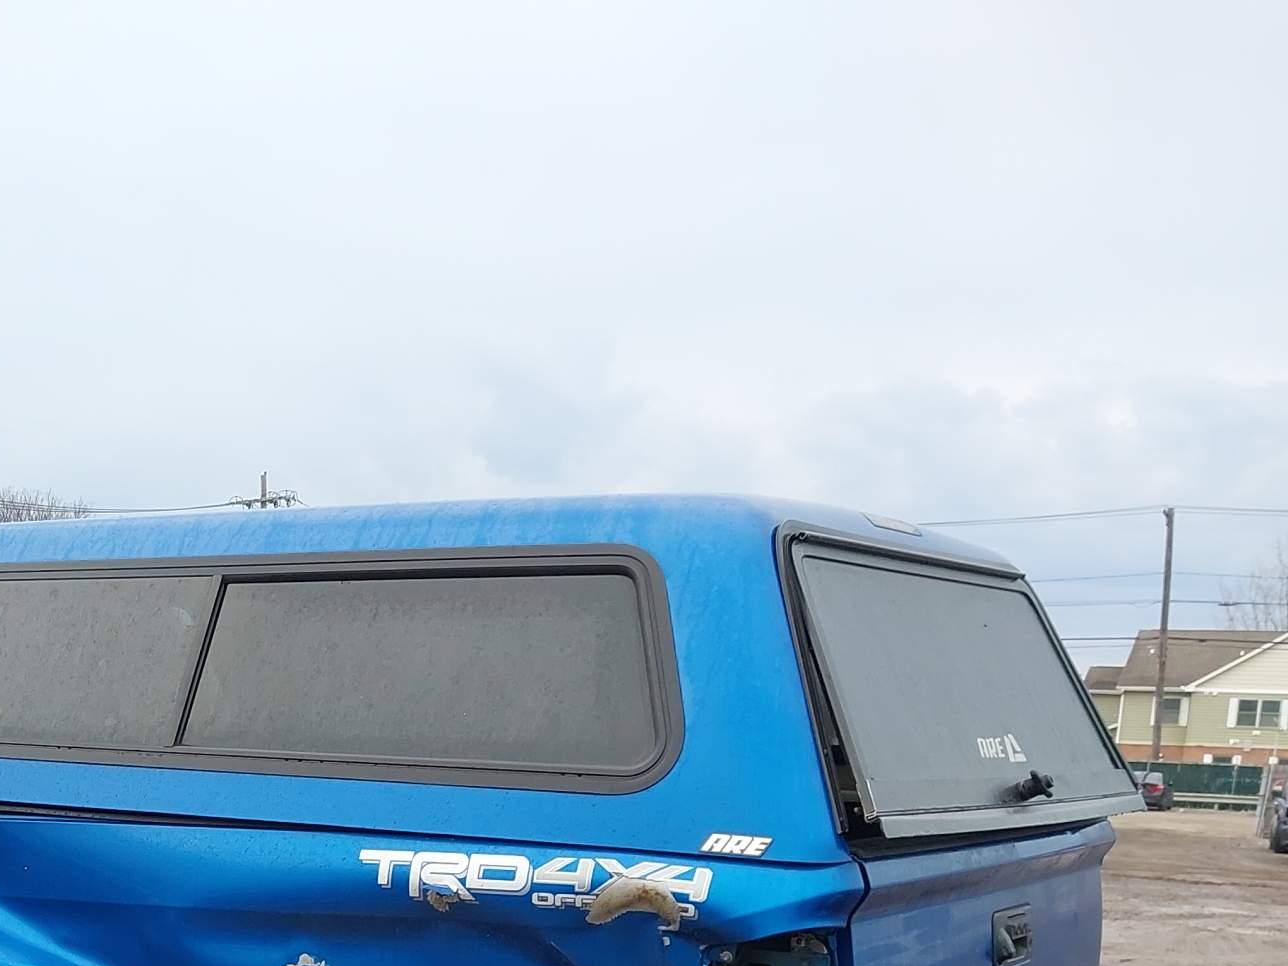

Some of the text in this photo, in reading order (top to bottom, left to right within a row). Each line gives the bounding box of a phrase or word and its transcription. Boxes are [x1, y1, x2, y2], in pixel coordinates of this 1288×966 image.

[976, 737, 1006, 759] ARE
[699, 833, 773, 857] ARE
[359, 849, 532, 905] TRD
